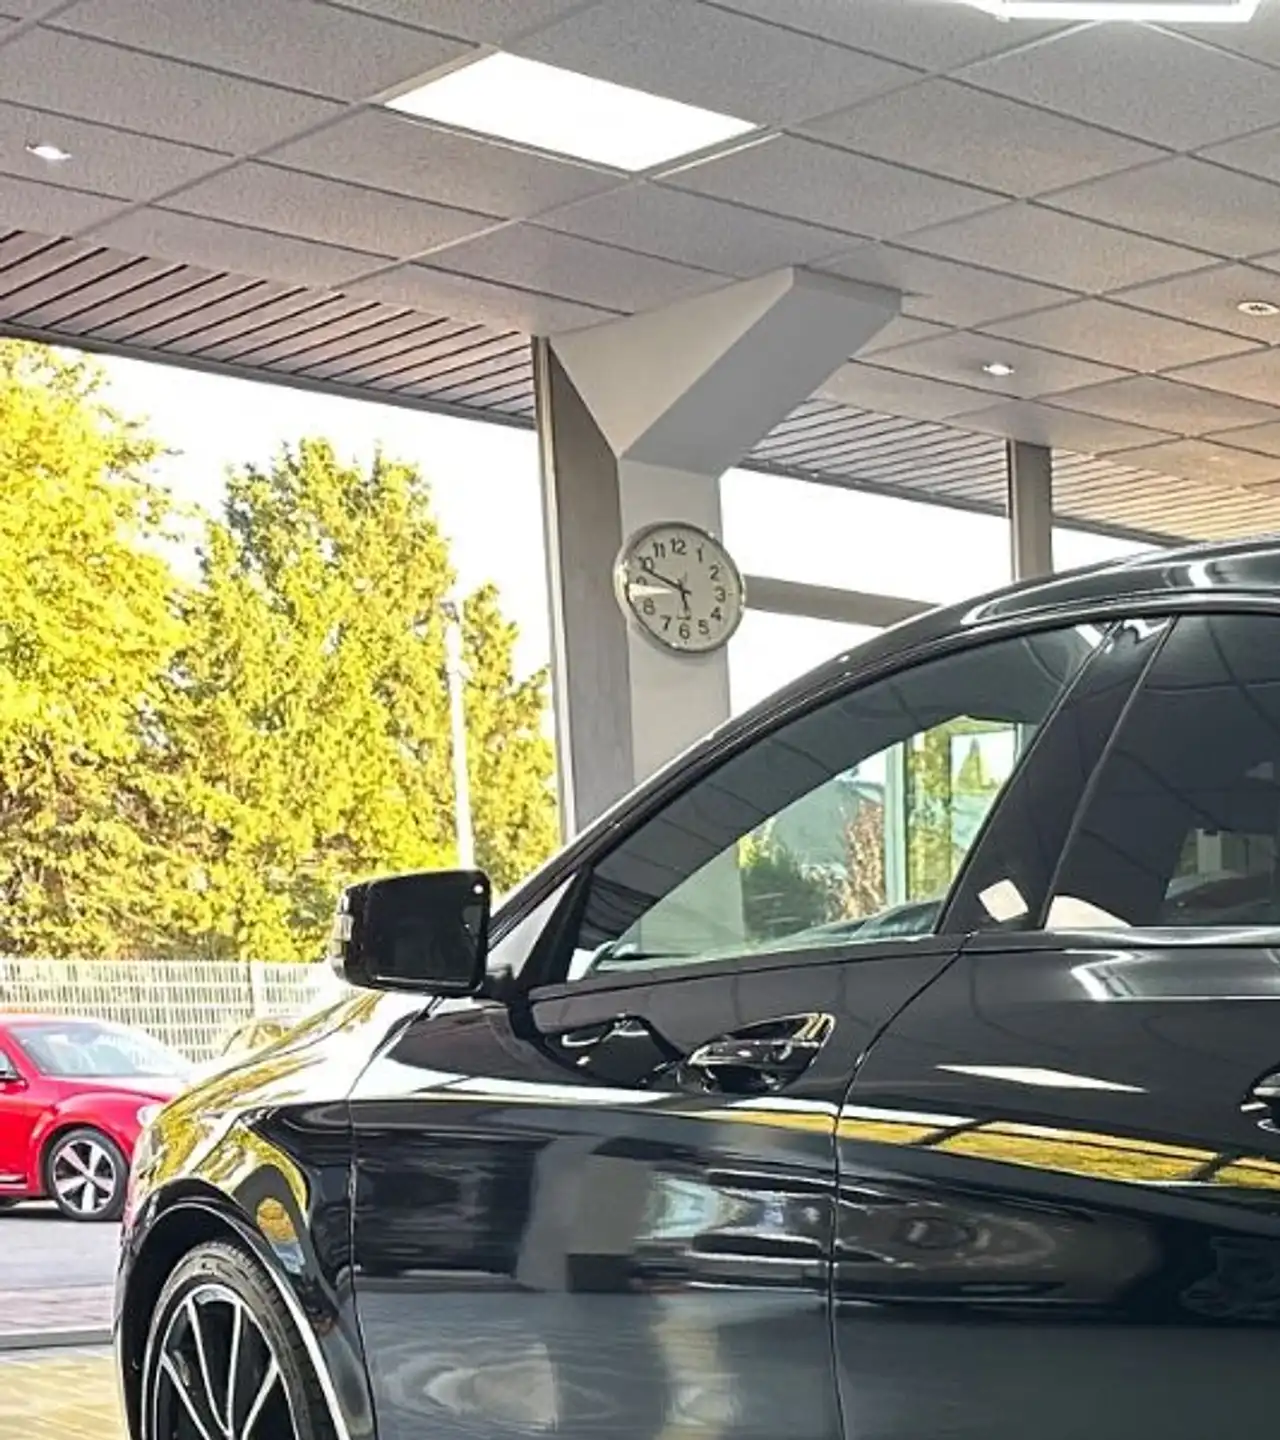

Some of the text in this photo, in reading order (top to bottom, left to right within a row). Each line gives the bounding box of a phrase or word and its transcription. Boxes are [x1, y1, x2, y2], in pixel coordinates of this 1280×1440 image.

[652, 542, 666, 559] 11
[670, 538, 687, 555] 12
[697, 547, 703, 563] 1
[638, 556, 655, 572] 10
[709, 565, 720, 580] 2
[714, 587, 726, 602] 3
[643, 598, 656, 615] 8
[710, 607, 722, 621] 4
[660, 615, 672, 631] 7
[698, 619, 710, 635] 5
[679, 623, 690, 640] 6
